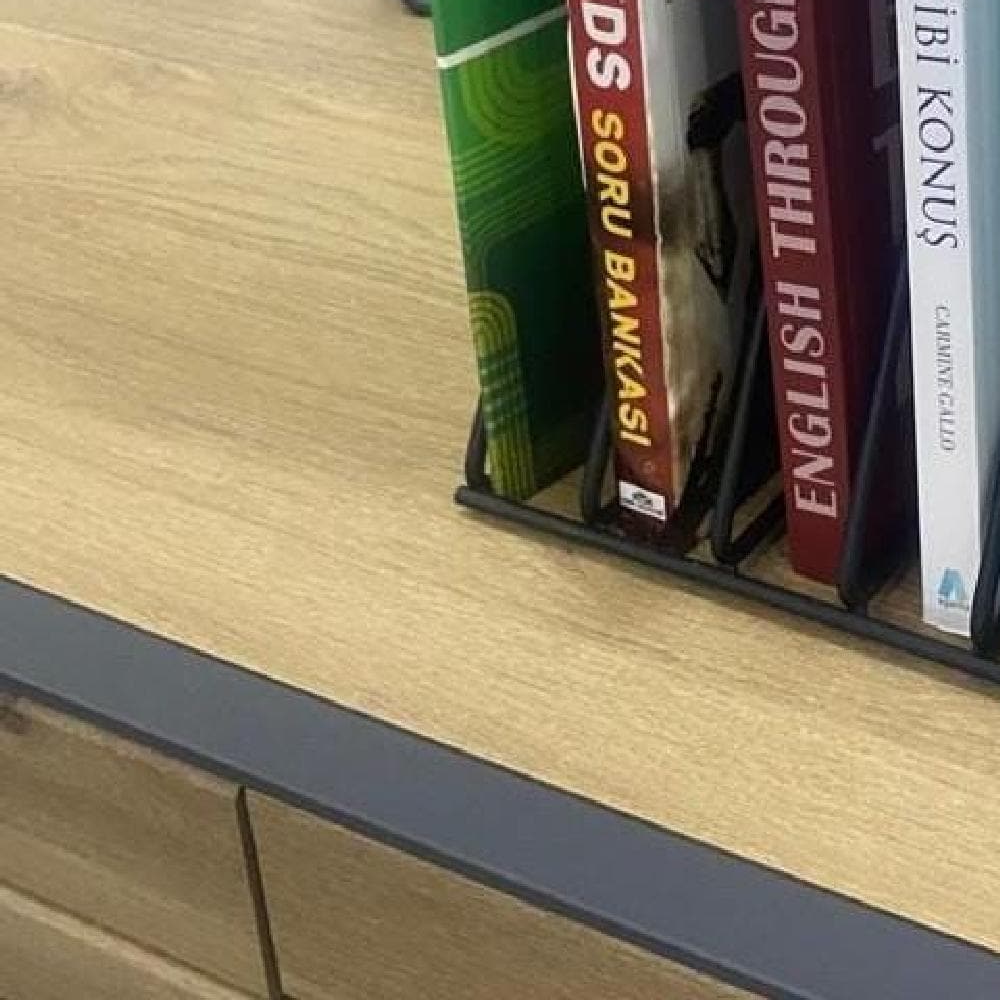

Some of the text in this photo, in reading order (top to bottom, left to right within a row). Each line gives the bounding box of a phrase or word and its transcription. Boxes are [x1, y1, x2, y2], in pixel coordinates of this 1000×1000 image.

[591, 108, 633, 238] SORU
[914, 85, 960, 251] KONUŞ
[601, 249, 652, 448] BANKASI
[779, 280, 838, 519] ENGLISH
[935, 305, 956, 451] CARMINE GALLO
